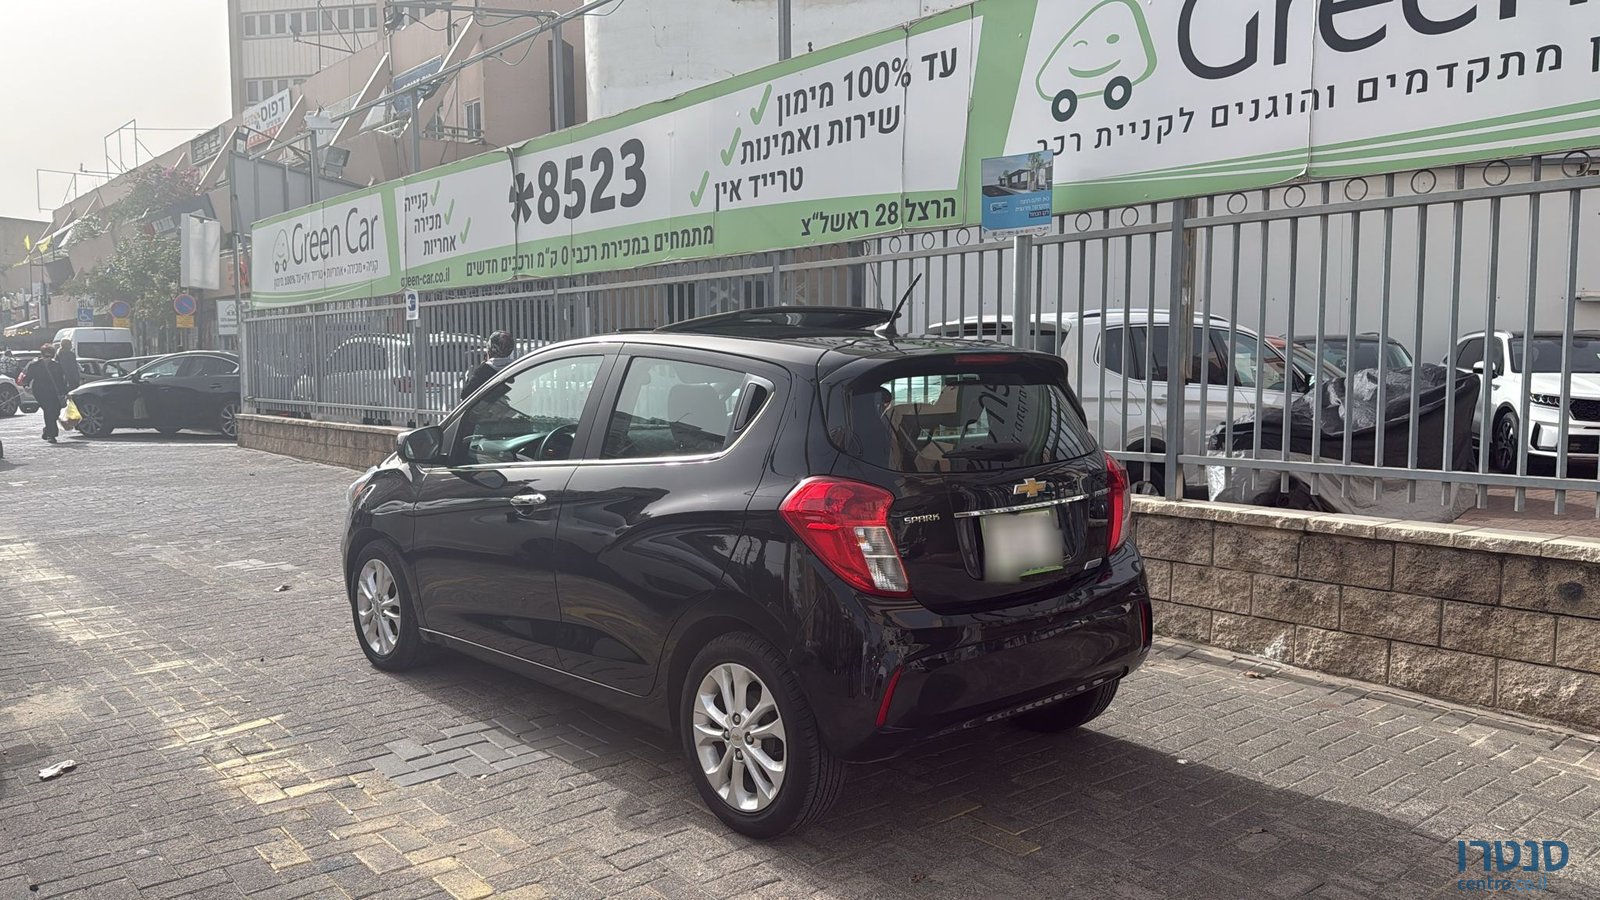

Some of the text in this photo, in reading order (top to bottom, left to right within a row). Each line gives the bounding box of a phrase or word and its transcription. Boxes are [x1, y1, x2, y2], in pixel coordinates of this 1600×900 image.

[1178, 0, 1588, 79] Gre
[1357, 44, 1562, 103] מתקדמים
[777, 47, 958, 126] עד 100% מימון
[260, 97, 285, 122] דפוס
[1211, 85, 1335, 128] והוגנים
[741, 105, 901, 165] שירות ואמינות
[1094, 106, 1195, 150] לקניית
[714, 165, 804, 211] טרייד אין
[404, 192, 428, 213] קנייה
[875, 201, 899, 226] 28
[905, 198, 956, 222] הרצל
[414, 213, 442, 234] מכירה
[291, 207, 378, 265] Green Car
[423, 235, 457, 256] אחריות
[654, 225, 714, 250] מתמחים
[560, 246, 569, 266] 0
[571, 244, 597, 264] רכבי
[601, 237, 650, 261] במכירת
[466, 256, 498, 277] חדשים
[501, 251, 534, 273] ורכבים
[400, 267, 450, 287] geen-car.co.il
[904, 513, 940, 525] SPARK
